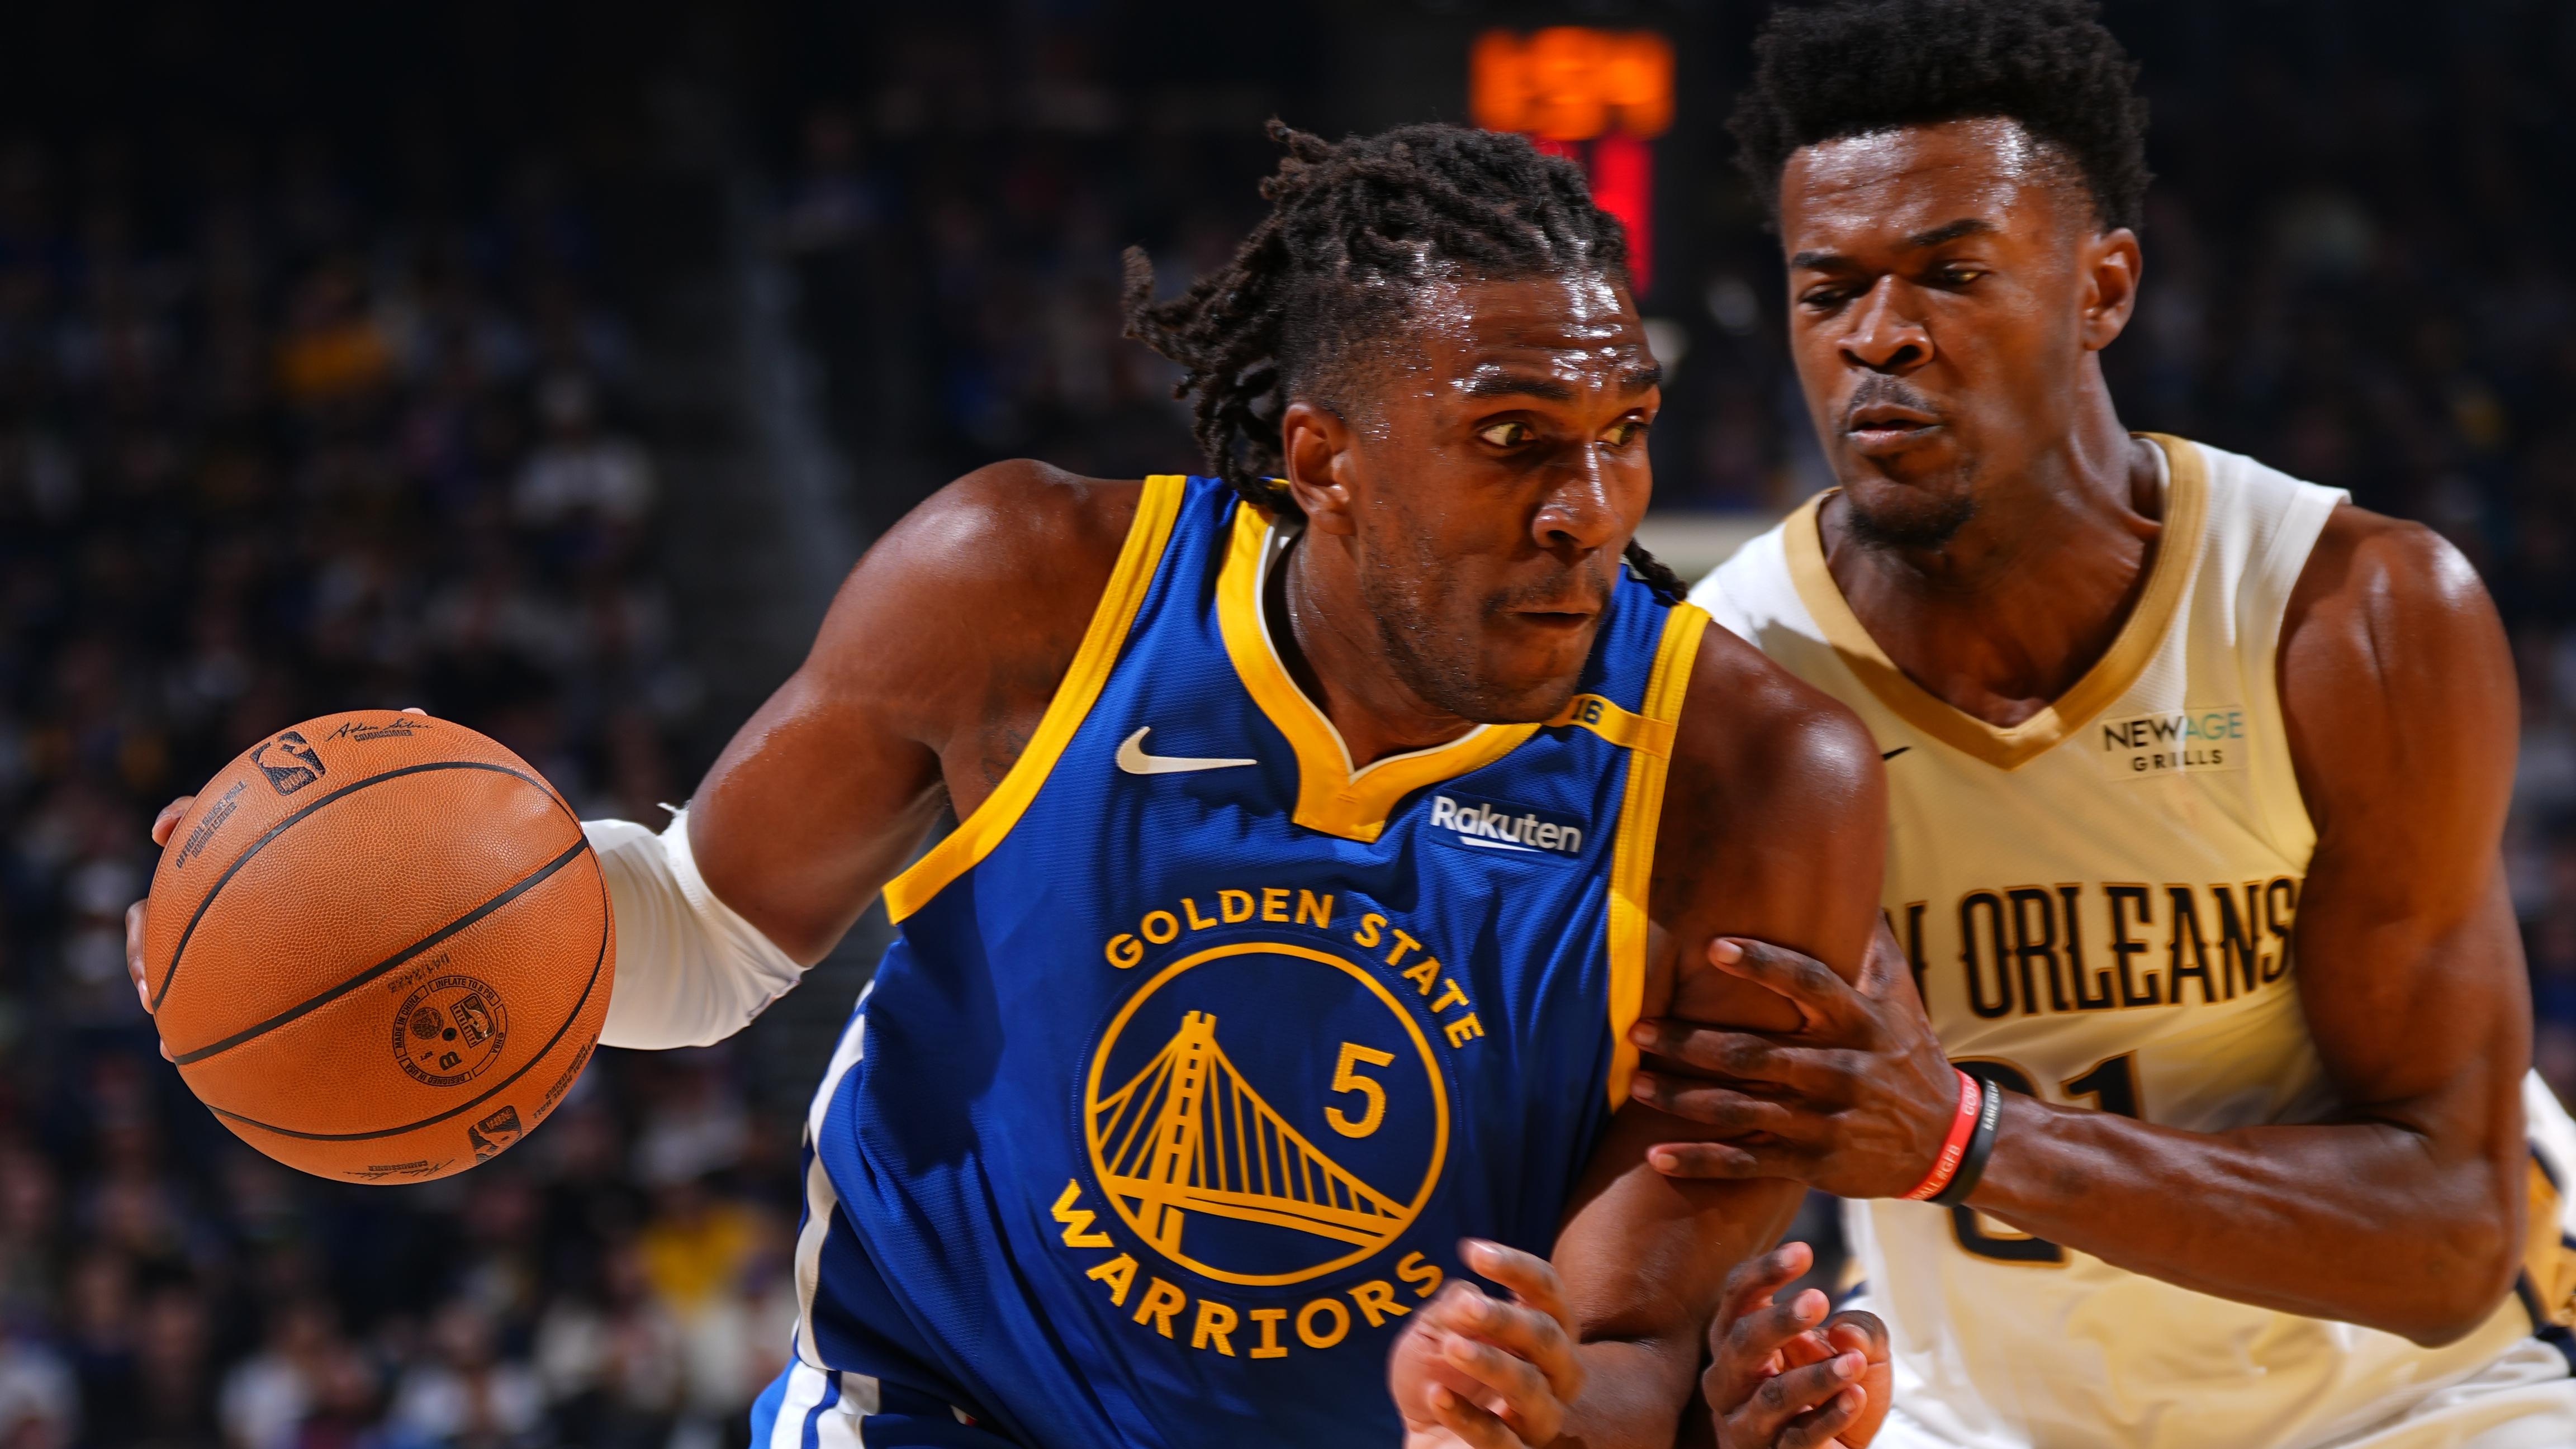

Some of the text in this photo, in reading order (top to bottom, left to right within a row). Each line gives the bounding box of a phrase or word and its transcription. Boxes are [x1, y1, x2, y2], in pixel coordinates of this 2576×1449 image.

[354, 729, 413, 742] COMMISSIONER
[2132, 749, 2223, 772] GRILLS
[280, 770, 308, 791] NBA
[176, 825, 205, 869] OFFICIAL
[191, 801, 237, 858] GENUINE LEATHER
[1430, 795, 1583, 853] Rakuten
[1104, 887, 1486, 1050] GOLDEN STATE
[1958, 876, 2299, 1022] ORLEANS
[435, 977, 495, 1001] INFLATE TO 8 PSI
[395, 994, 420, 1049] MADE IN CHINA
[405, 1062, 465, 1085] DESIGNED IN USA
[1323, 1041, 1396, 1139] 5
[1051, 1179, 1444, 1360] WARRIORS
